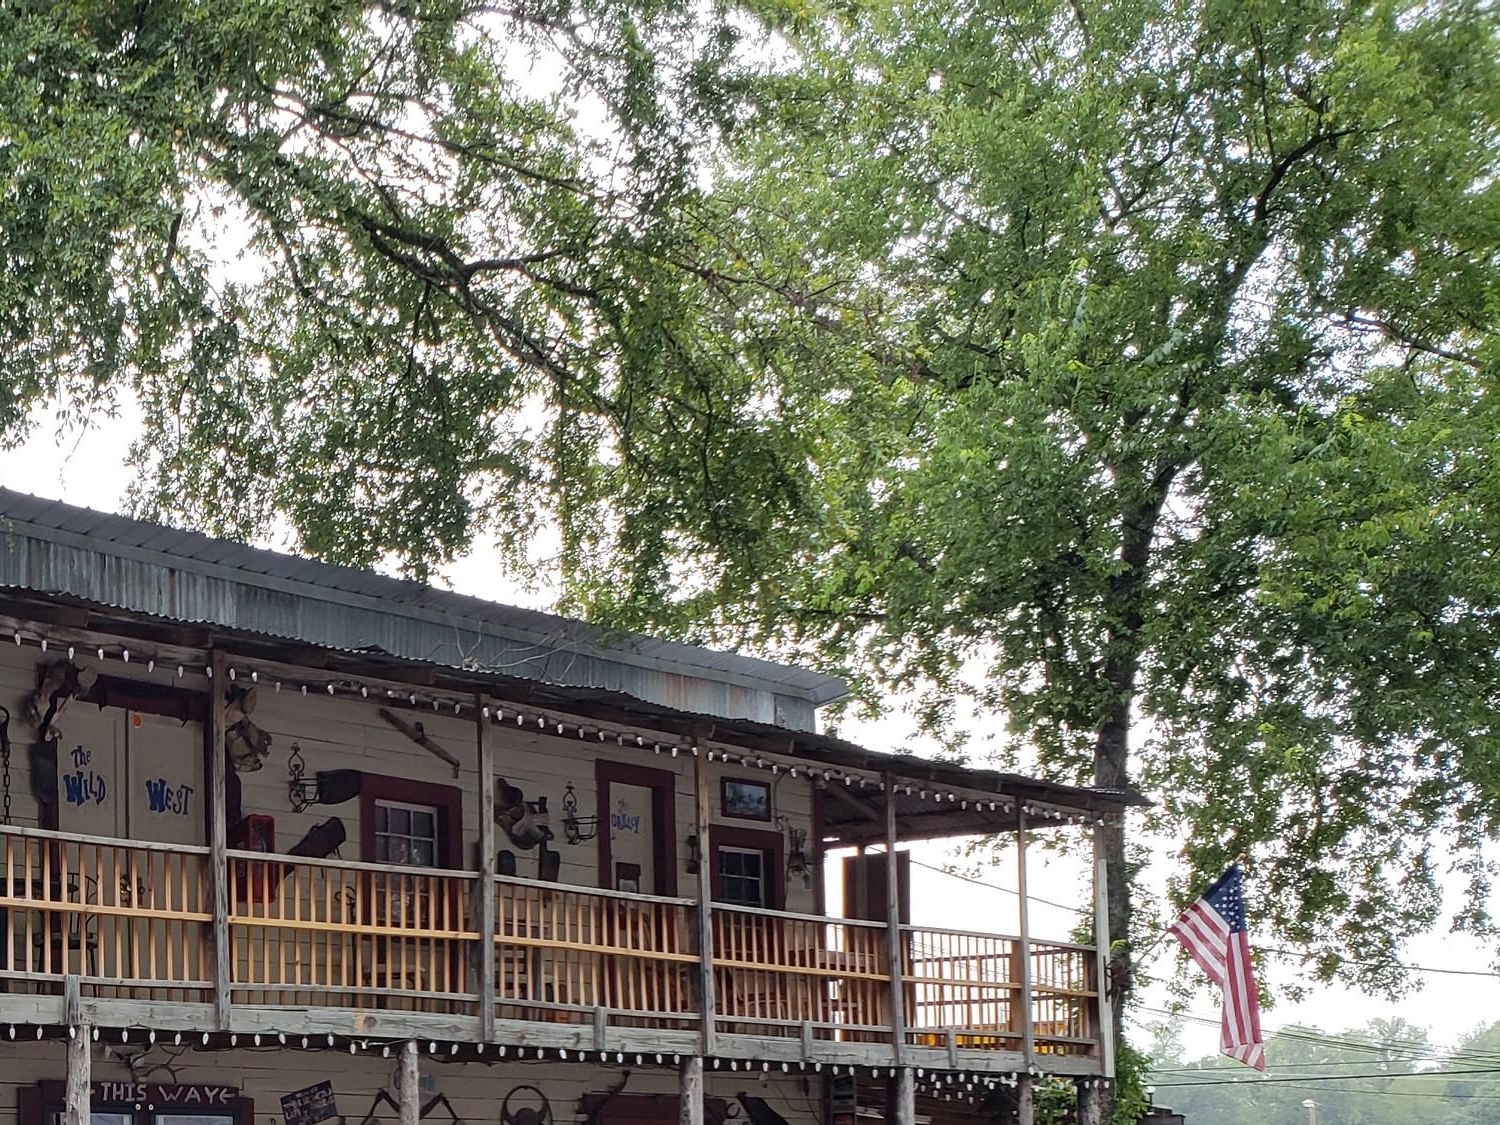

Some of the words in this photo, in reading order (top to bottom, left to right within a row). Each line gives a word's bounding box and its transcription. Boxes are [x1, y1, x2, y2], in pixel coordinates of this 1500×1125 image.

[145, 778, 194, 815] WEST
[100, 1082, 148, 1103] THIS
[158, 1085, 219, 1105] WAY
